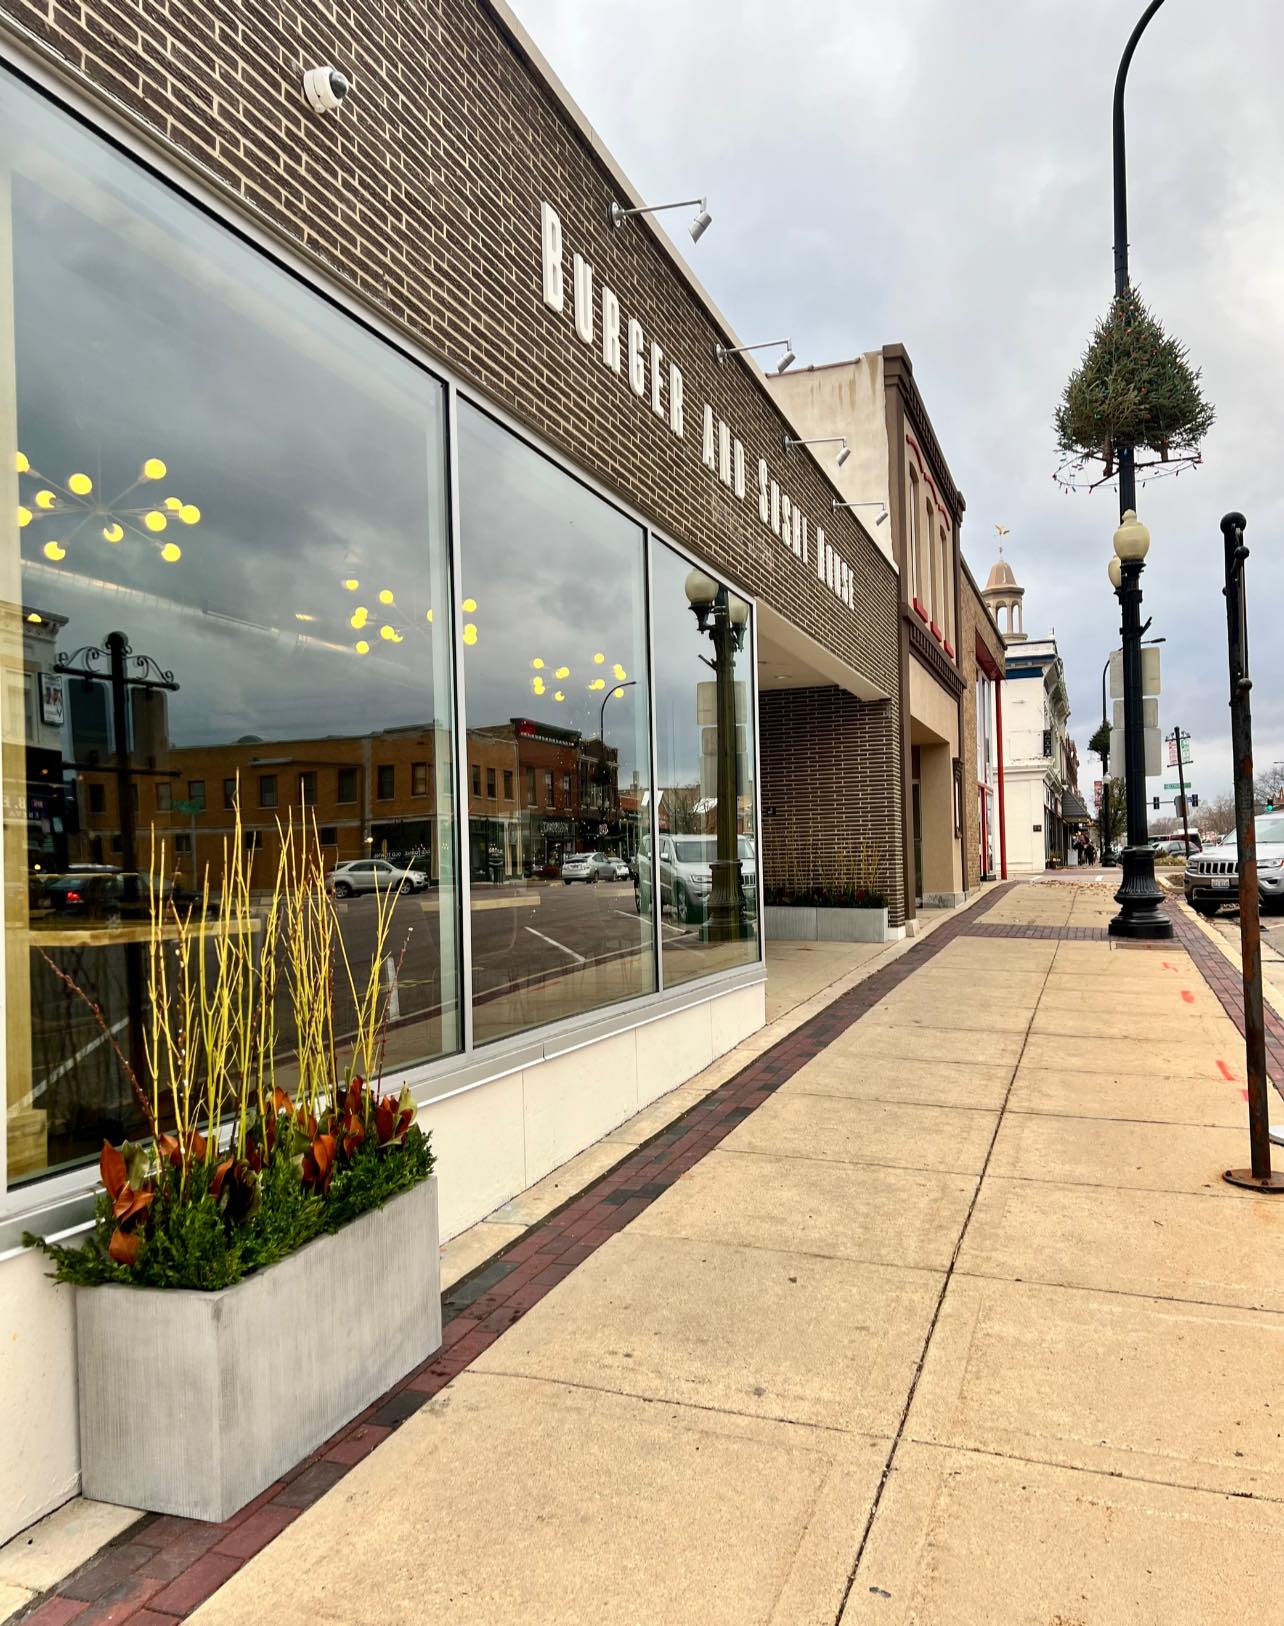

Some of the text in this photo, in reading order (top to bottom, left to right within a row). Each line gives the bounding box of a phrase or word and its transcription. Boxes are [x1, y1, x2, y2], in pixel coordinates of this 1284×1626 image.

[541, 200, 854, 611] BURGER AND SUSHI HOUSE
